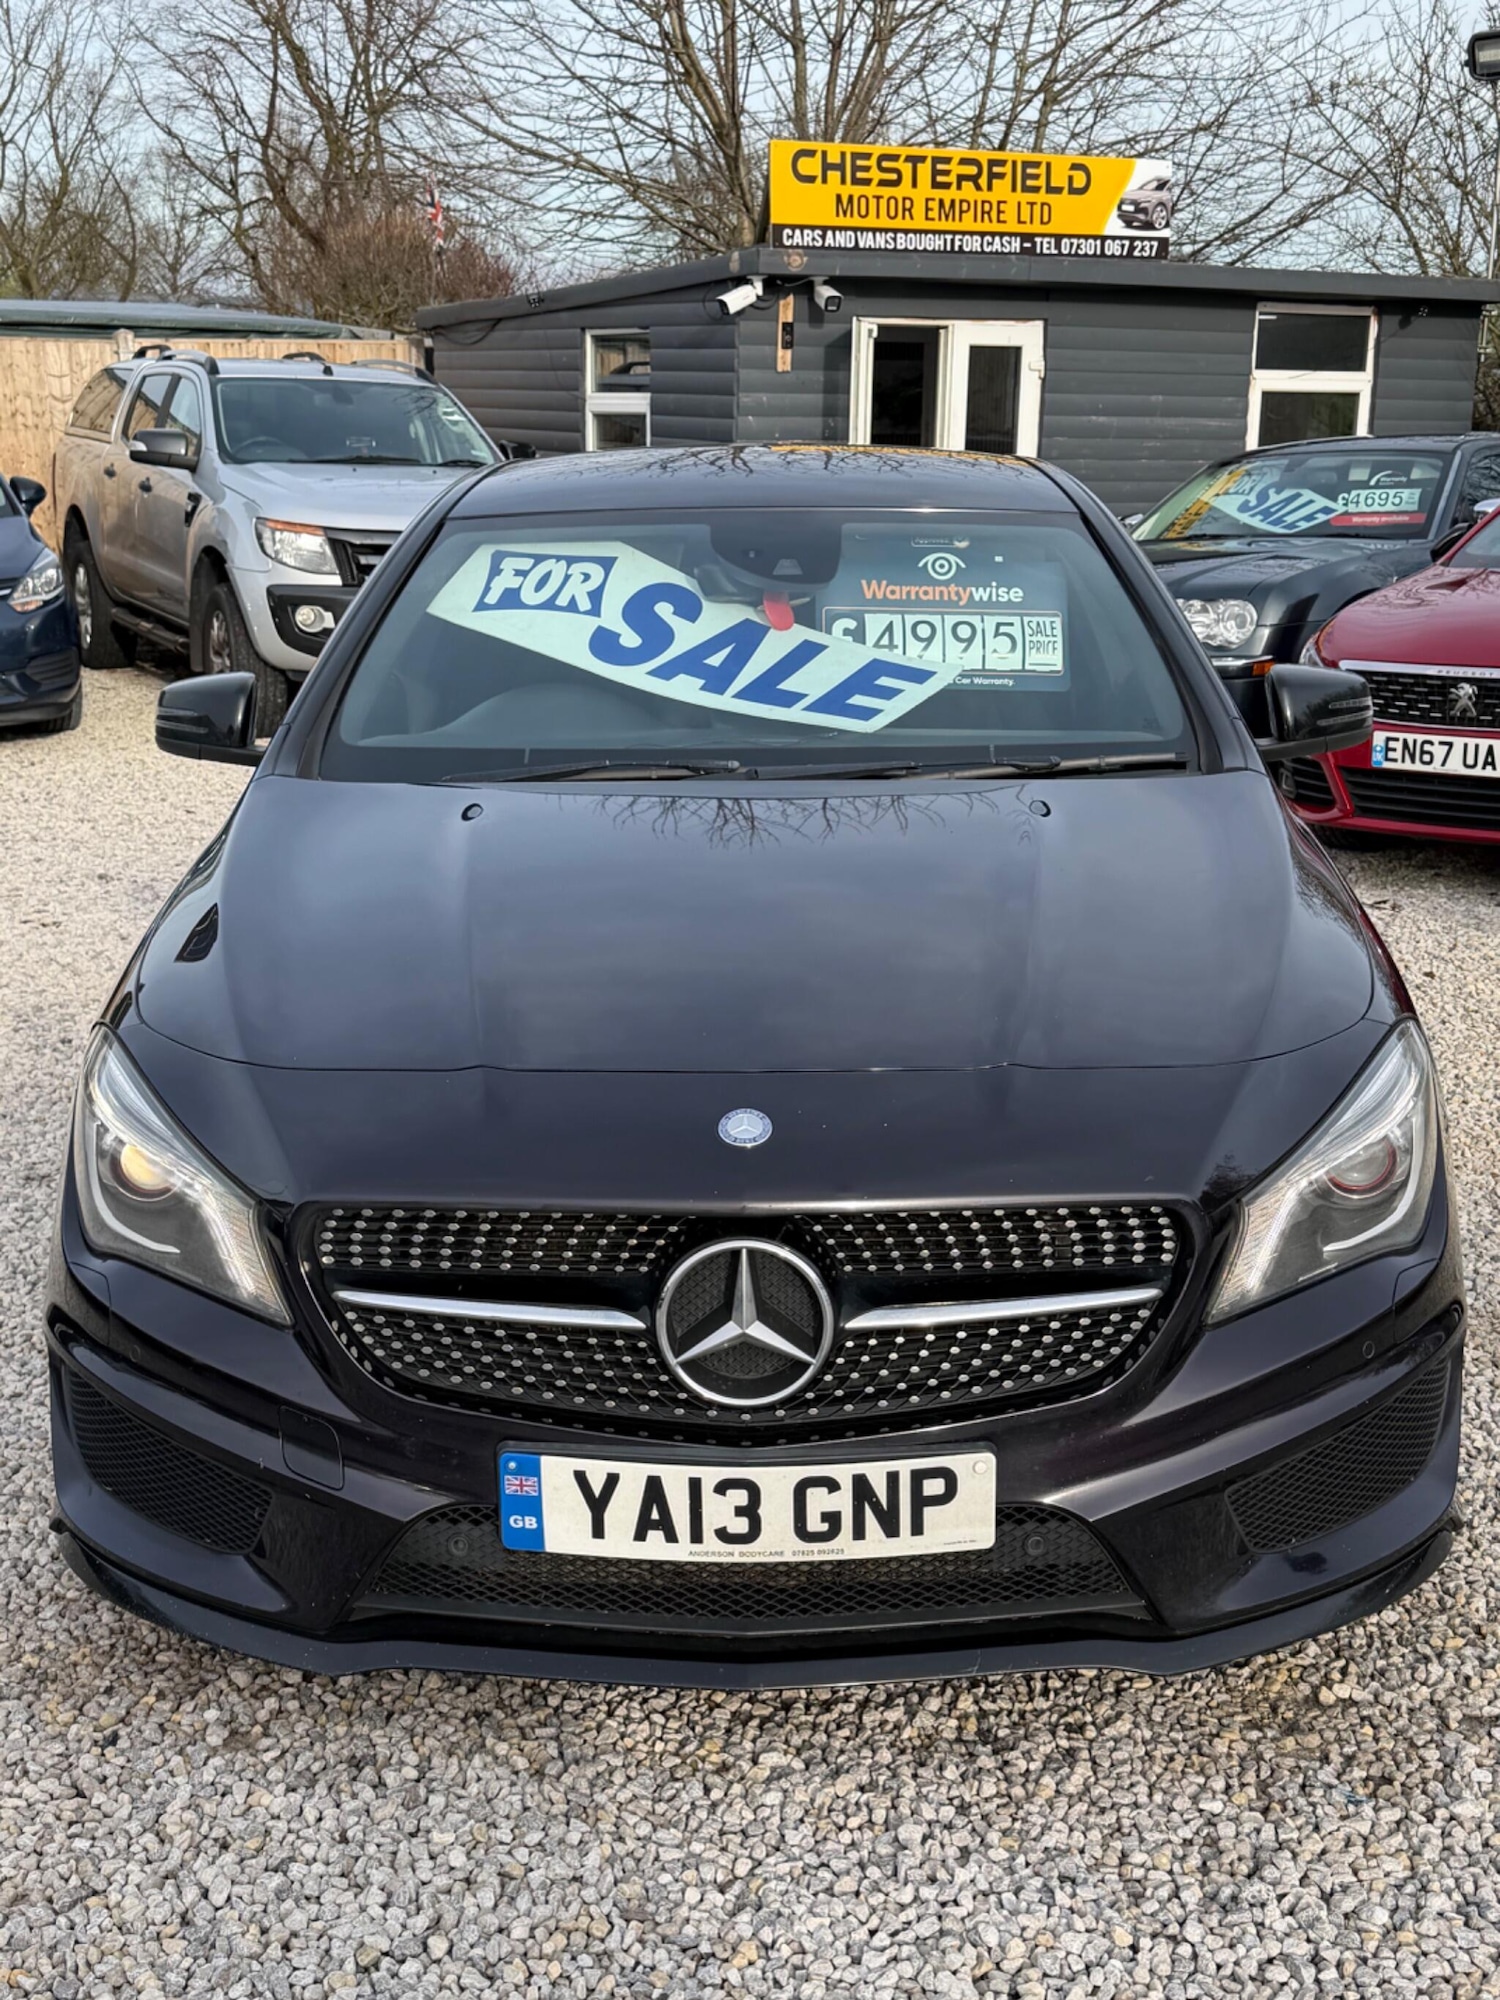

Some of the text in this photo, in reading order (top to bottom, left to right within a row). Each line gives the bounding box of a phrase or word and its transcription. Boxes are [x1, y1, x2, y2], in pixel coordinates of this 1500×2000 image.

[791, 148, 1092, 196] CHESTERFIELD
[835, 193, 1053, 226] MOTOR EMPIRE LTD
[782, 228, 823, 247] CARS
[824, 230, 858, 248] AND
[857, 231, 896, 250] VANS
[896, 232, 954, 251] BOUGHT
[956, 234, 983, 252] FOR
[983, 235, 1020, 253] CASH
[1035, 237, 1059, 255] TEL
[1061, 237, 1102, 255] 07301
[1104, 238, 1129, 256] 067
[1133, 239, 1159, 257] 237
[1236, 481, 1339, 530] SALE
[484, 555, 605, 614] FOR
[861, 579, 1025, 605] Warrantywise
[1027, 620, 1058, 637] SALE
[588, 581, 936, 723] SALE
[1028, 640, 1058, 657] PRICE
[1384, 736, 1497, 772] EN67 UA
[509, 1514, 539, 1530] GB
[572, 1466, 960, 1546] YA13 GNP
[687, 1550, 735, 1558] ANDERSON
[738, 1549, 785, 1558] BODYCARE
